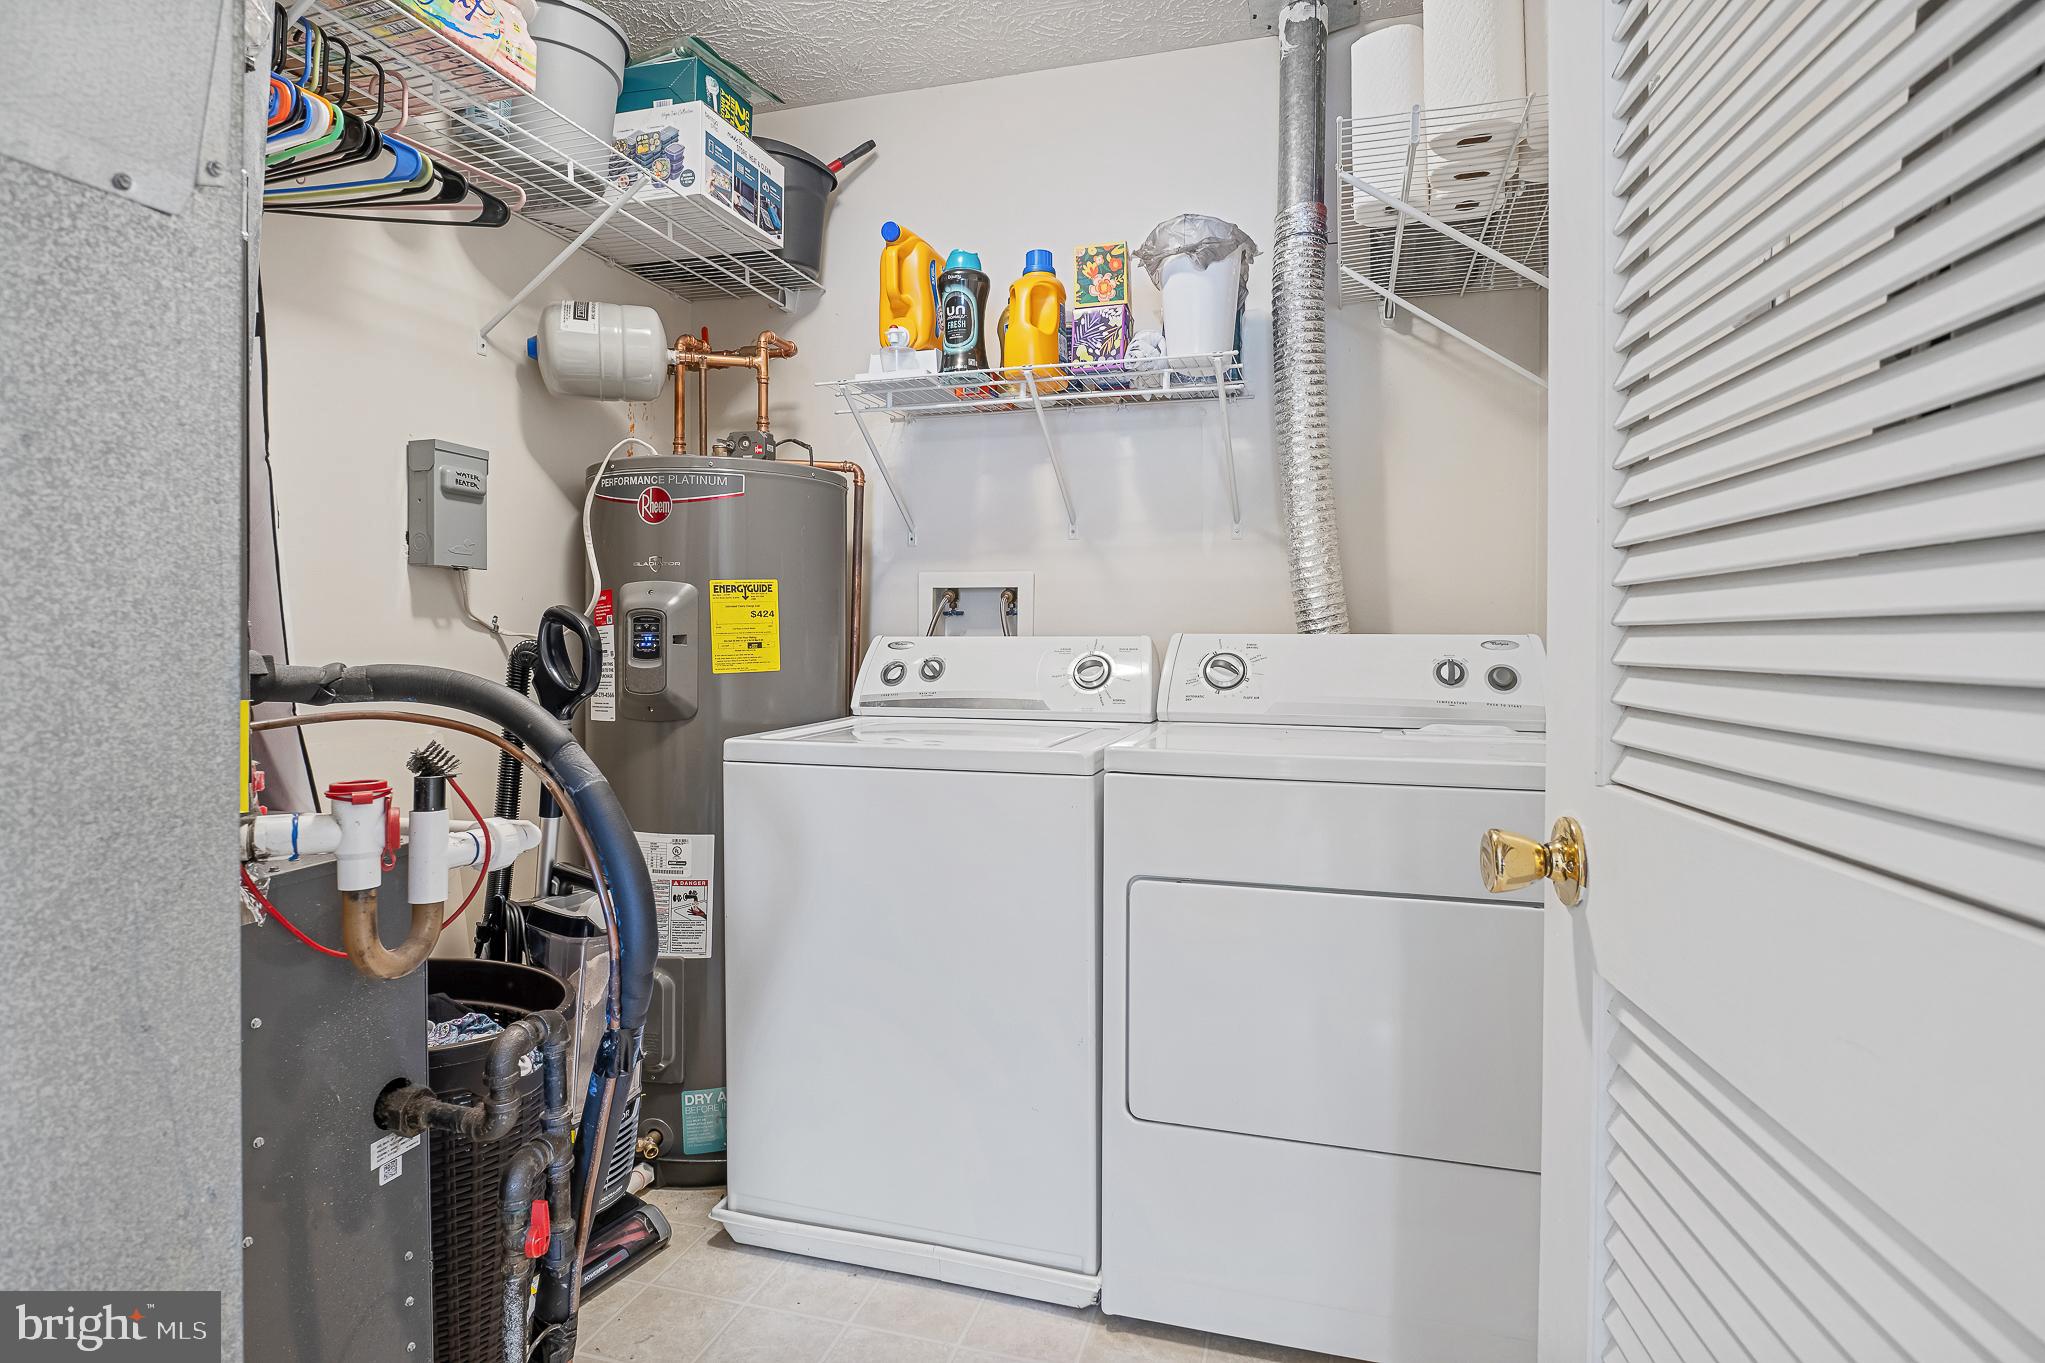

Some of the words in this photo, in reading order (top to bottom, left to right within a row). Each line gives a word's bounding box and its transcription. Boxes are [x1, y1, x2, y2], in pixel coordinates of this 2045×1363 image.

[947, 320, 967, 330] FRESH
[455, 471, 481, 483] WATER
[601, 474, 665, 488] PERFORMANCE
[668, 474, 728, 486] PLATINUM
[642, 488, 670, 519] Rheem
[713, 583, 773, 594] ENERGYGUIDE
[750, 610, 775, 619] $424
[684, 1092, 714, 1106] DRY
[684, 1103, 720, 1115] BEFORE
